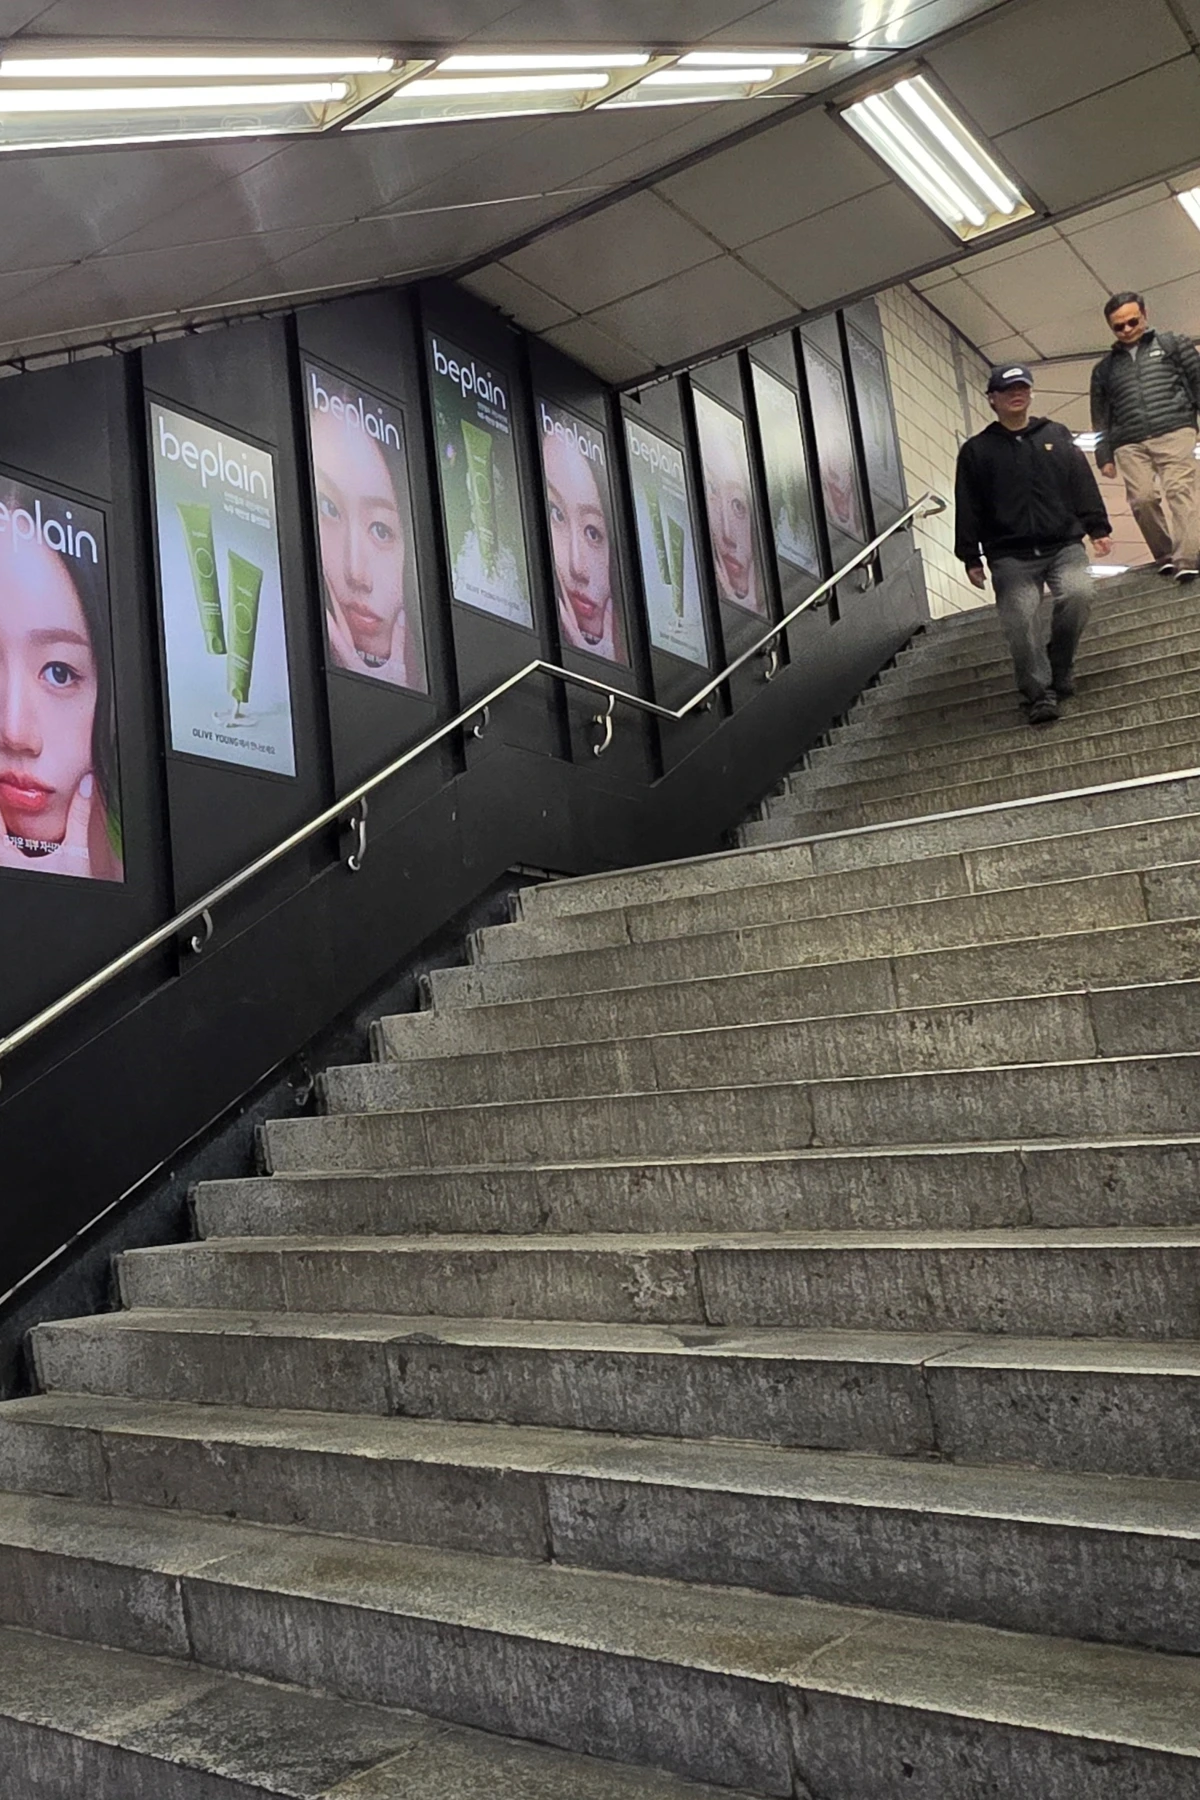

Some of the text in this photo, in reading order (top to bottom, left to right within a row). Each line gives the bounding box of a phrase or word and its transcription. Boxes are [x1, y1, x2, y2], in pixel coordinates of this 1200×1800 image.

[311, 372, 400, 450] beplain
[432, 338, 506, 411] beplain
[158, 415, 268, 499] beplain
[541, 403, 603, 466] beplain
